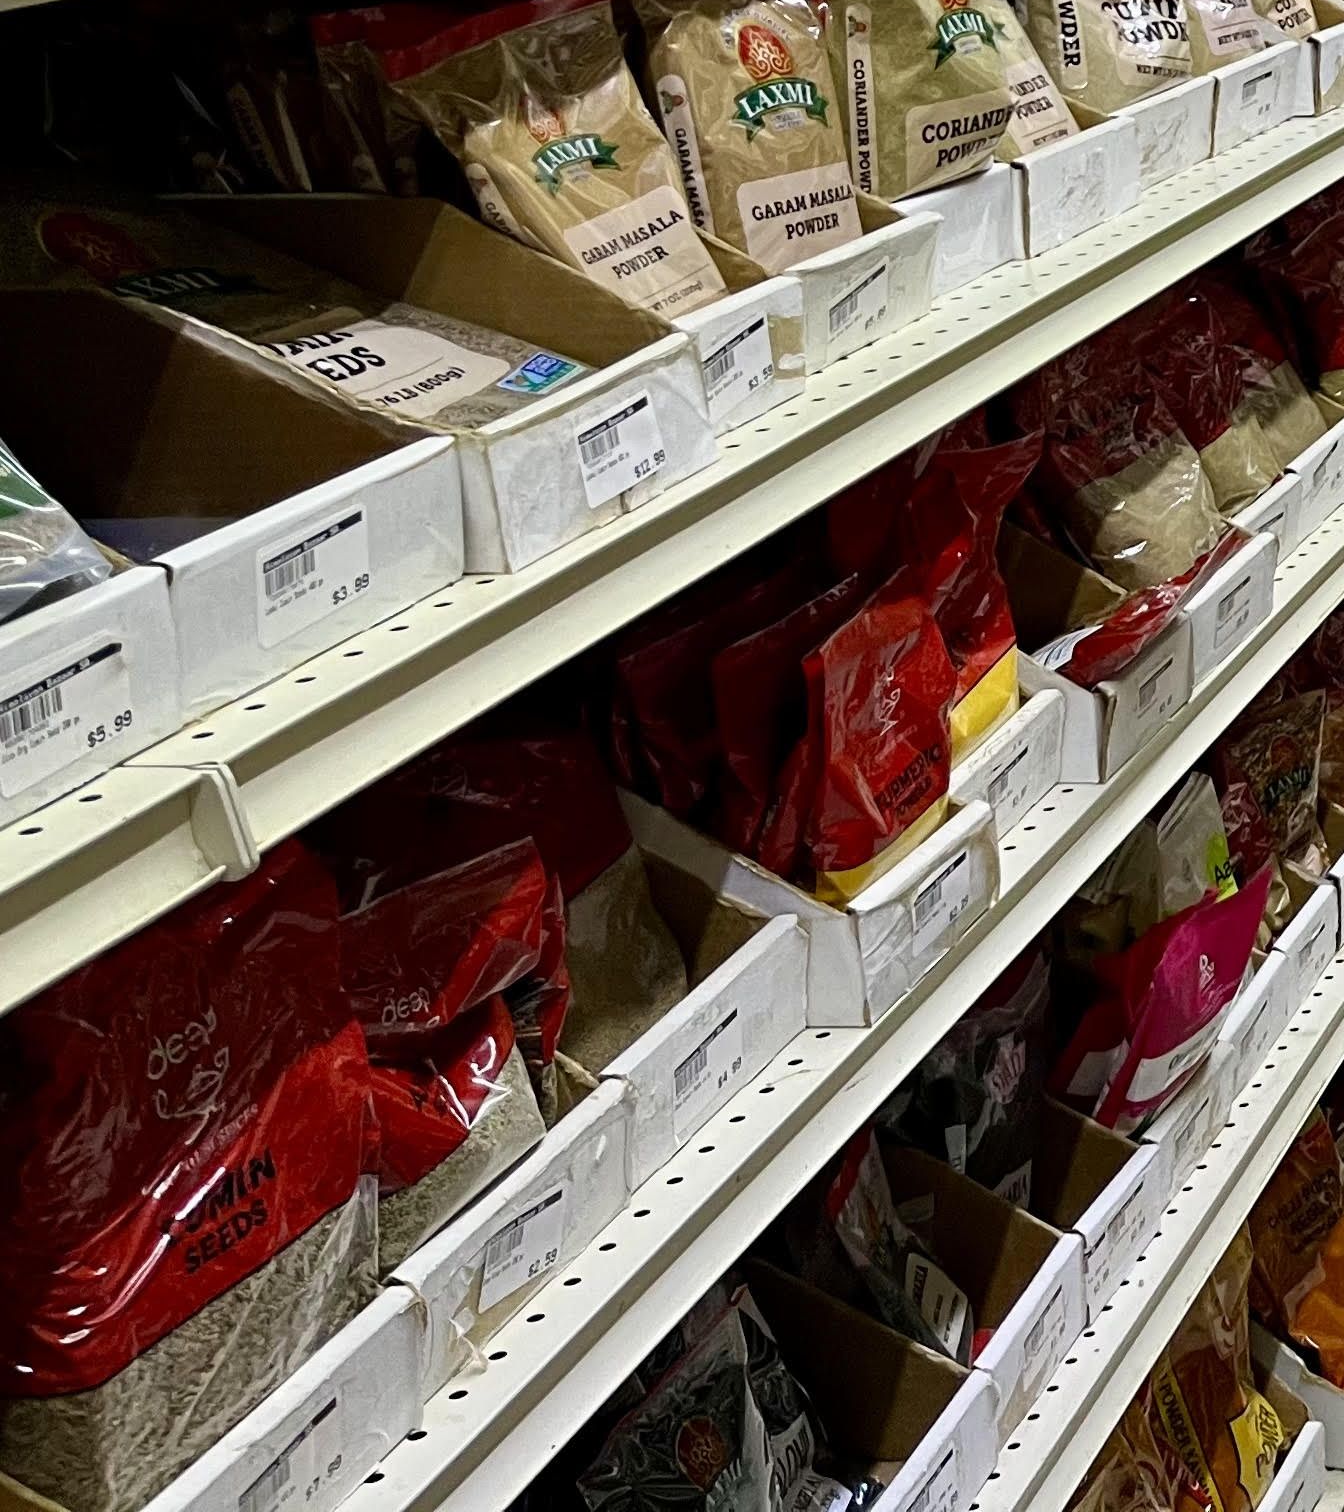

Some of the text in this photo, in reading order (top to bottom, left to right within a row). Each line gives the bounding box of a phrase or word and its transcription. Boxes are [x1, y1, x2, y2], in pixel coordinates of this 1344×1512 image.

[937, 11, 987, 44] LAXMI
[742, 82, 813, 115] LAXMI
[853, 58, 870, 149] CORIANDER
[537, 137, 600, 178] LAXMI
[751, 185, 853, 225] GARAM MASALA
[581, 207, 684, 268] GARAM MASALA
[784, 215, 841, 242] POWDER
[611, 245, 669, 280] POWDER
[86, 708, 135, 750] $5.99
[183, 1201, 269, 1274] SEEDS
